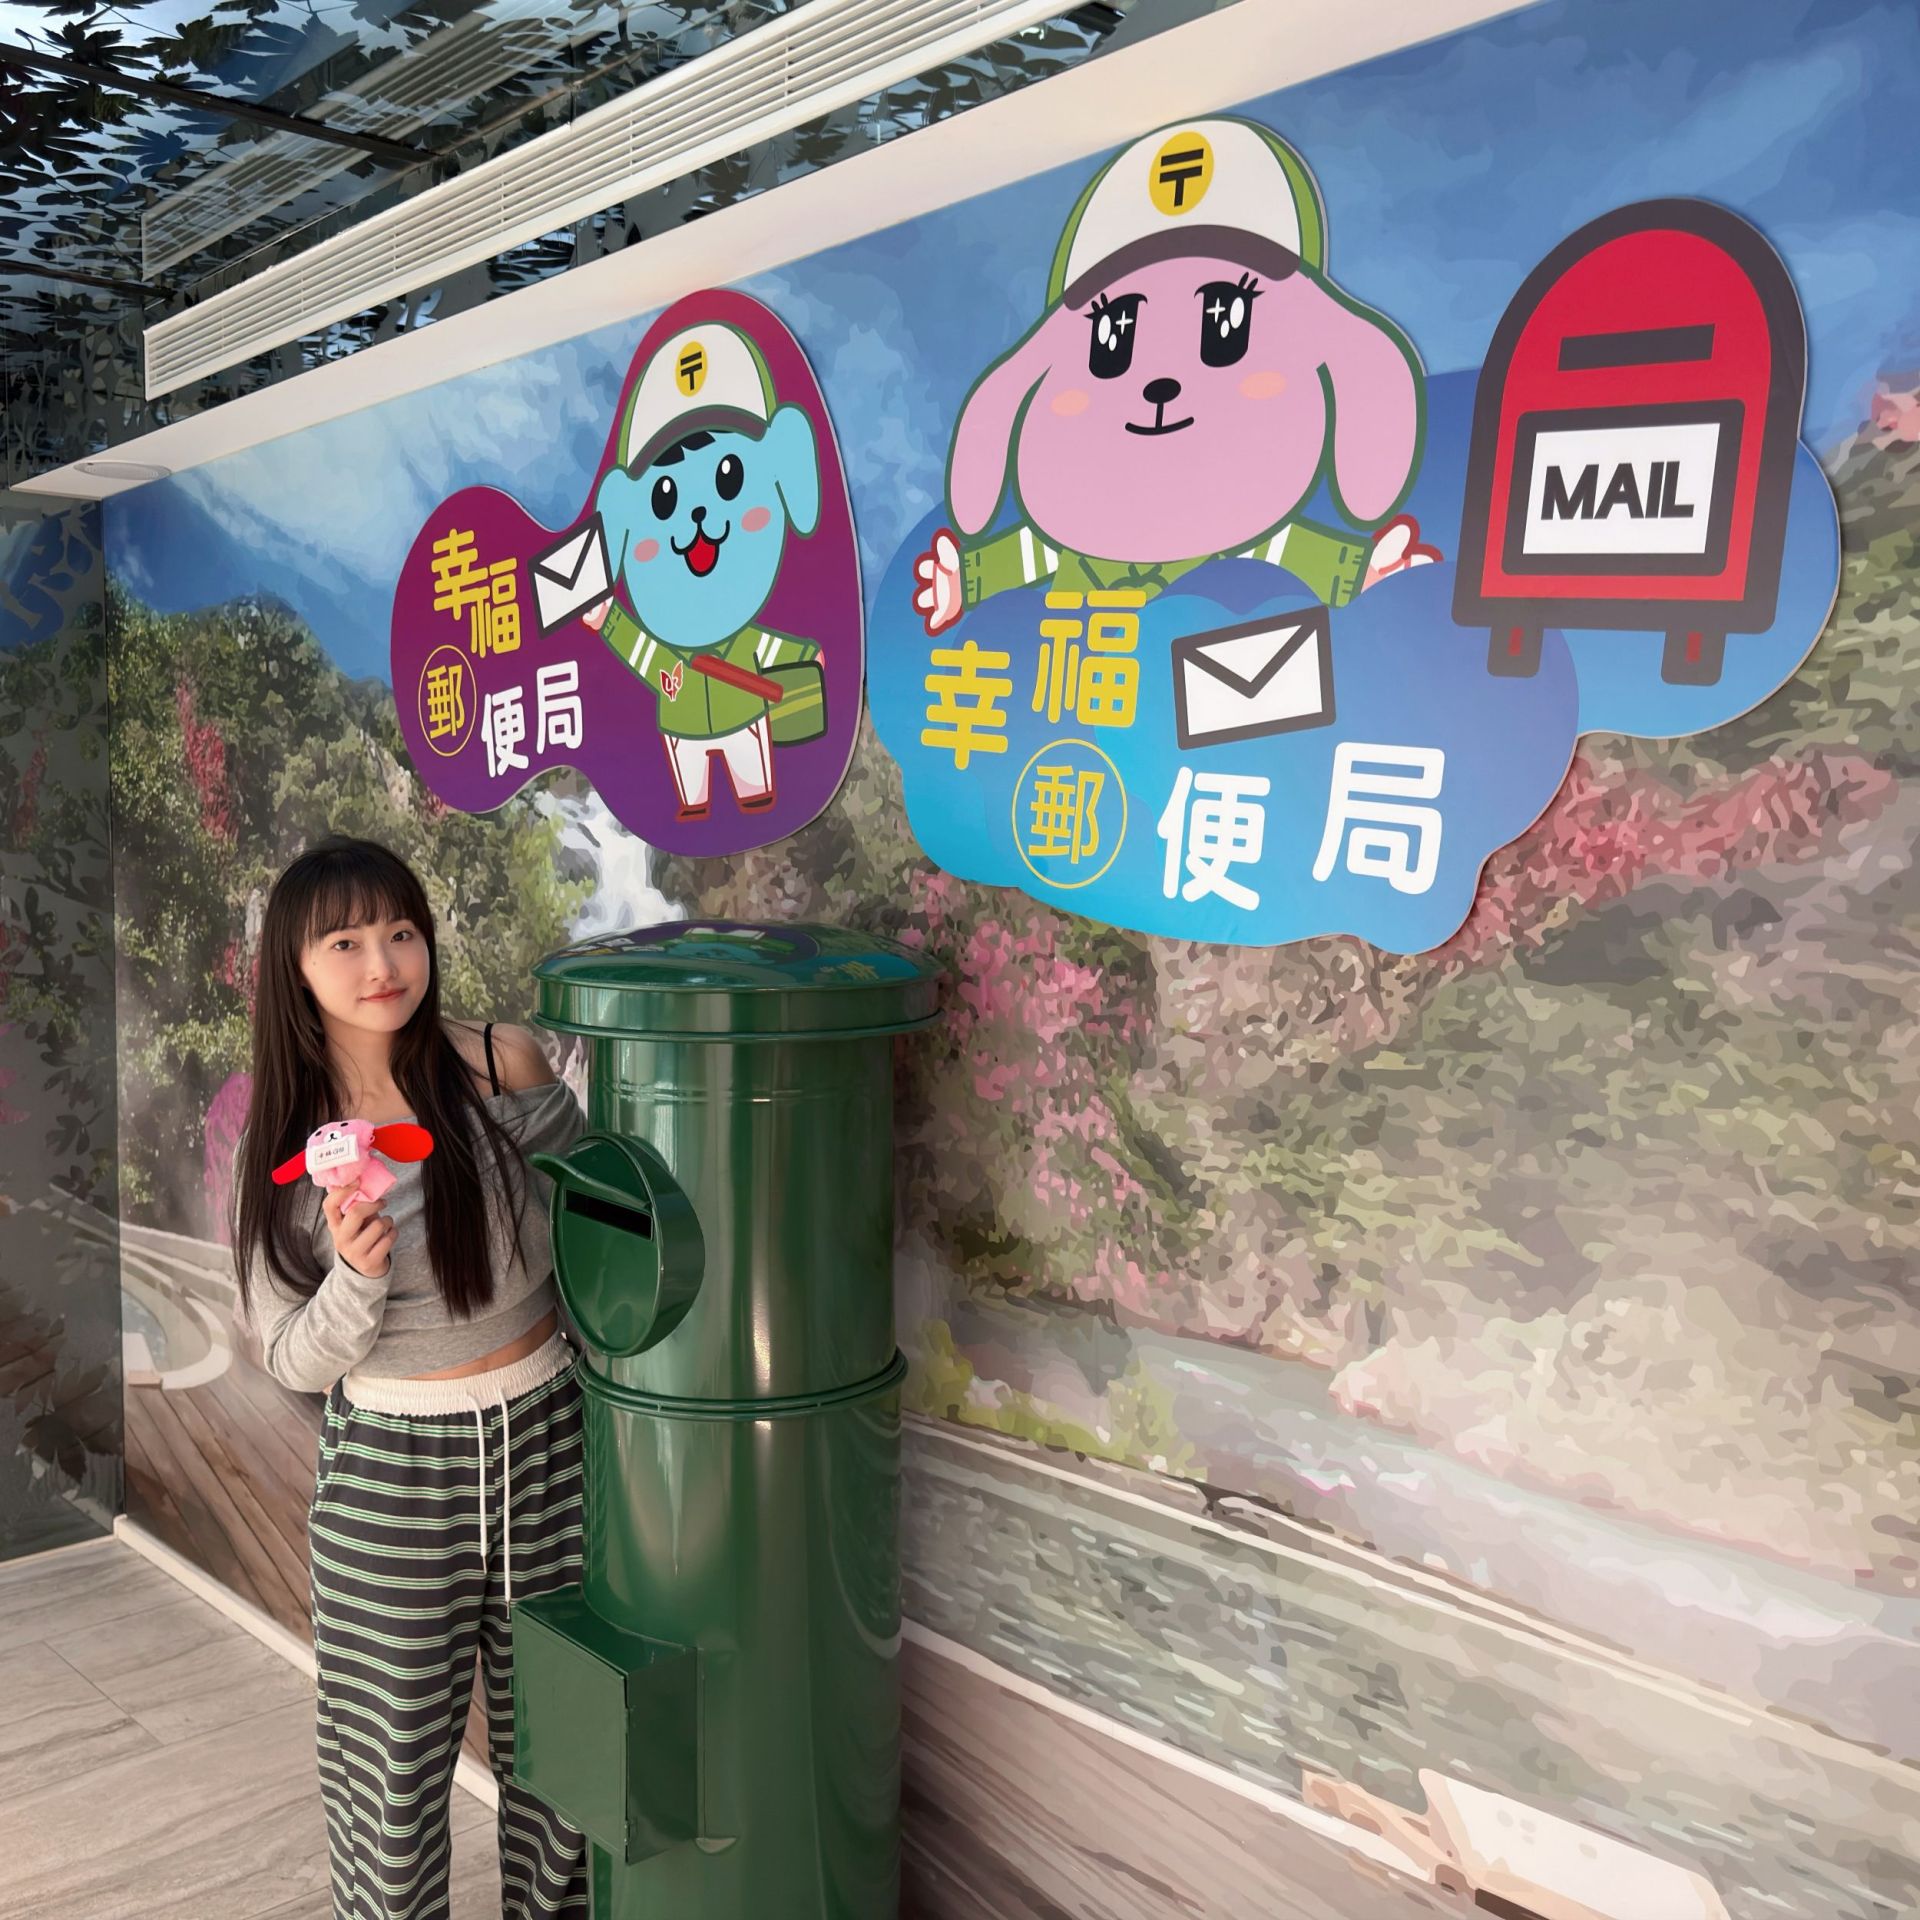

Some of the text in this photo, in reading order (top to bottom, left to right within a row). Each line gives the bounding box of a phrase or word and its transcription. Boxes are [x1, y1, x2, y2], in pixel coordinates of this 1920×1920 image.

[1540, 460, 1695, 521] MAIL
[430, 528, 522, 659] 幸福
[426, 660, 584, 777] 郵便局
[920, 590, 1147, 770] 幸福
[1028, 741, 1446, 911] 郵便局
